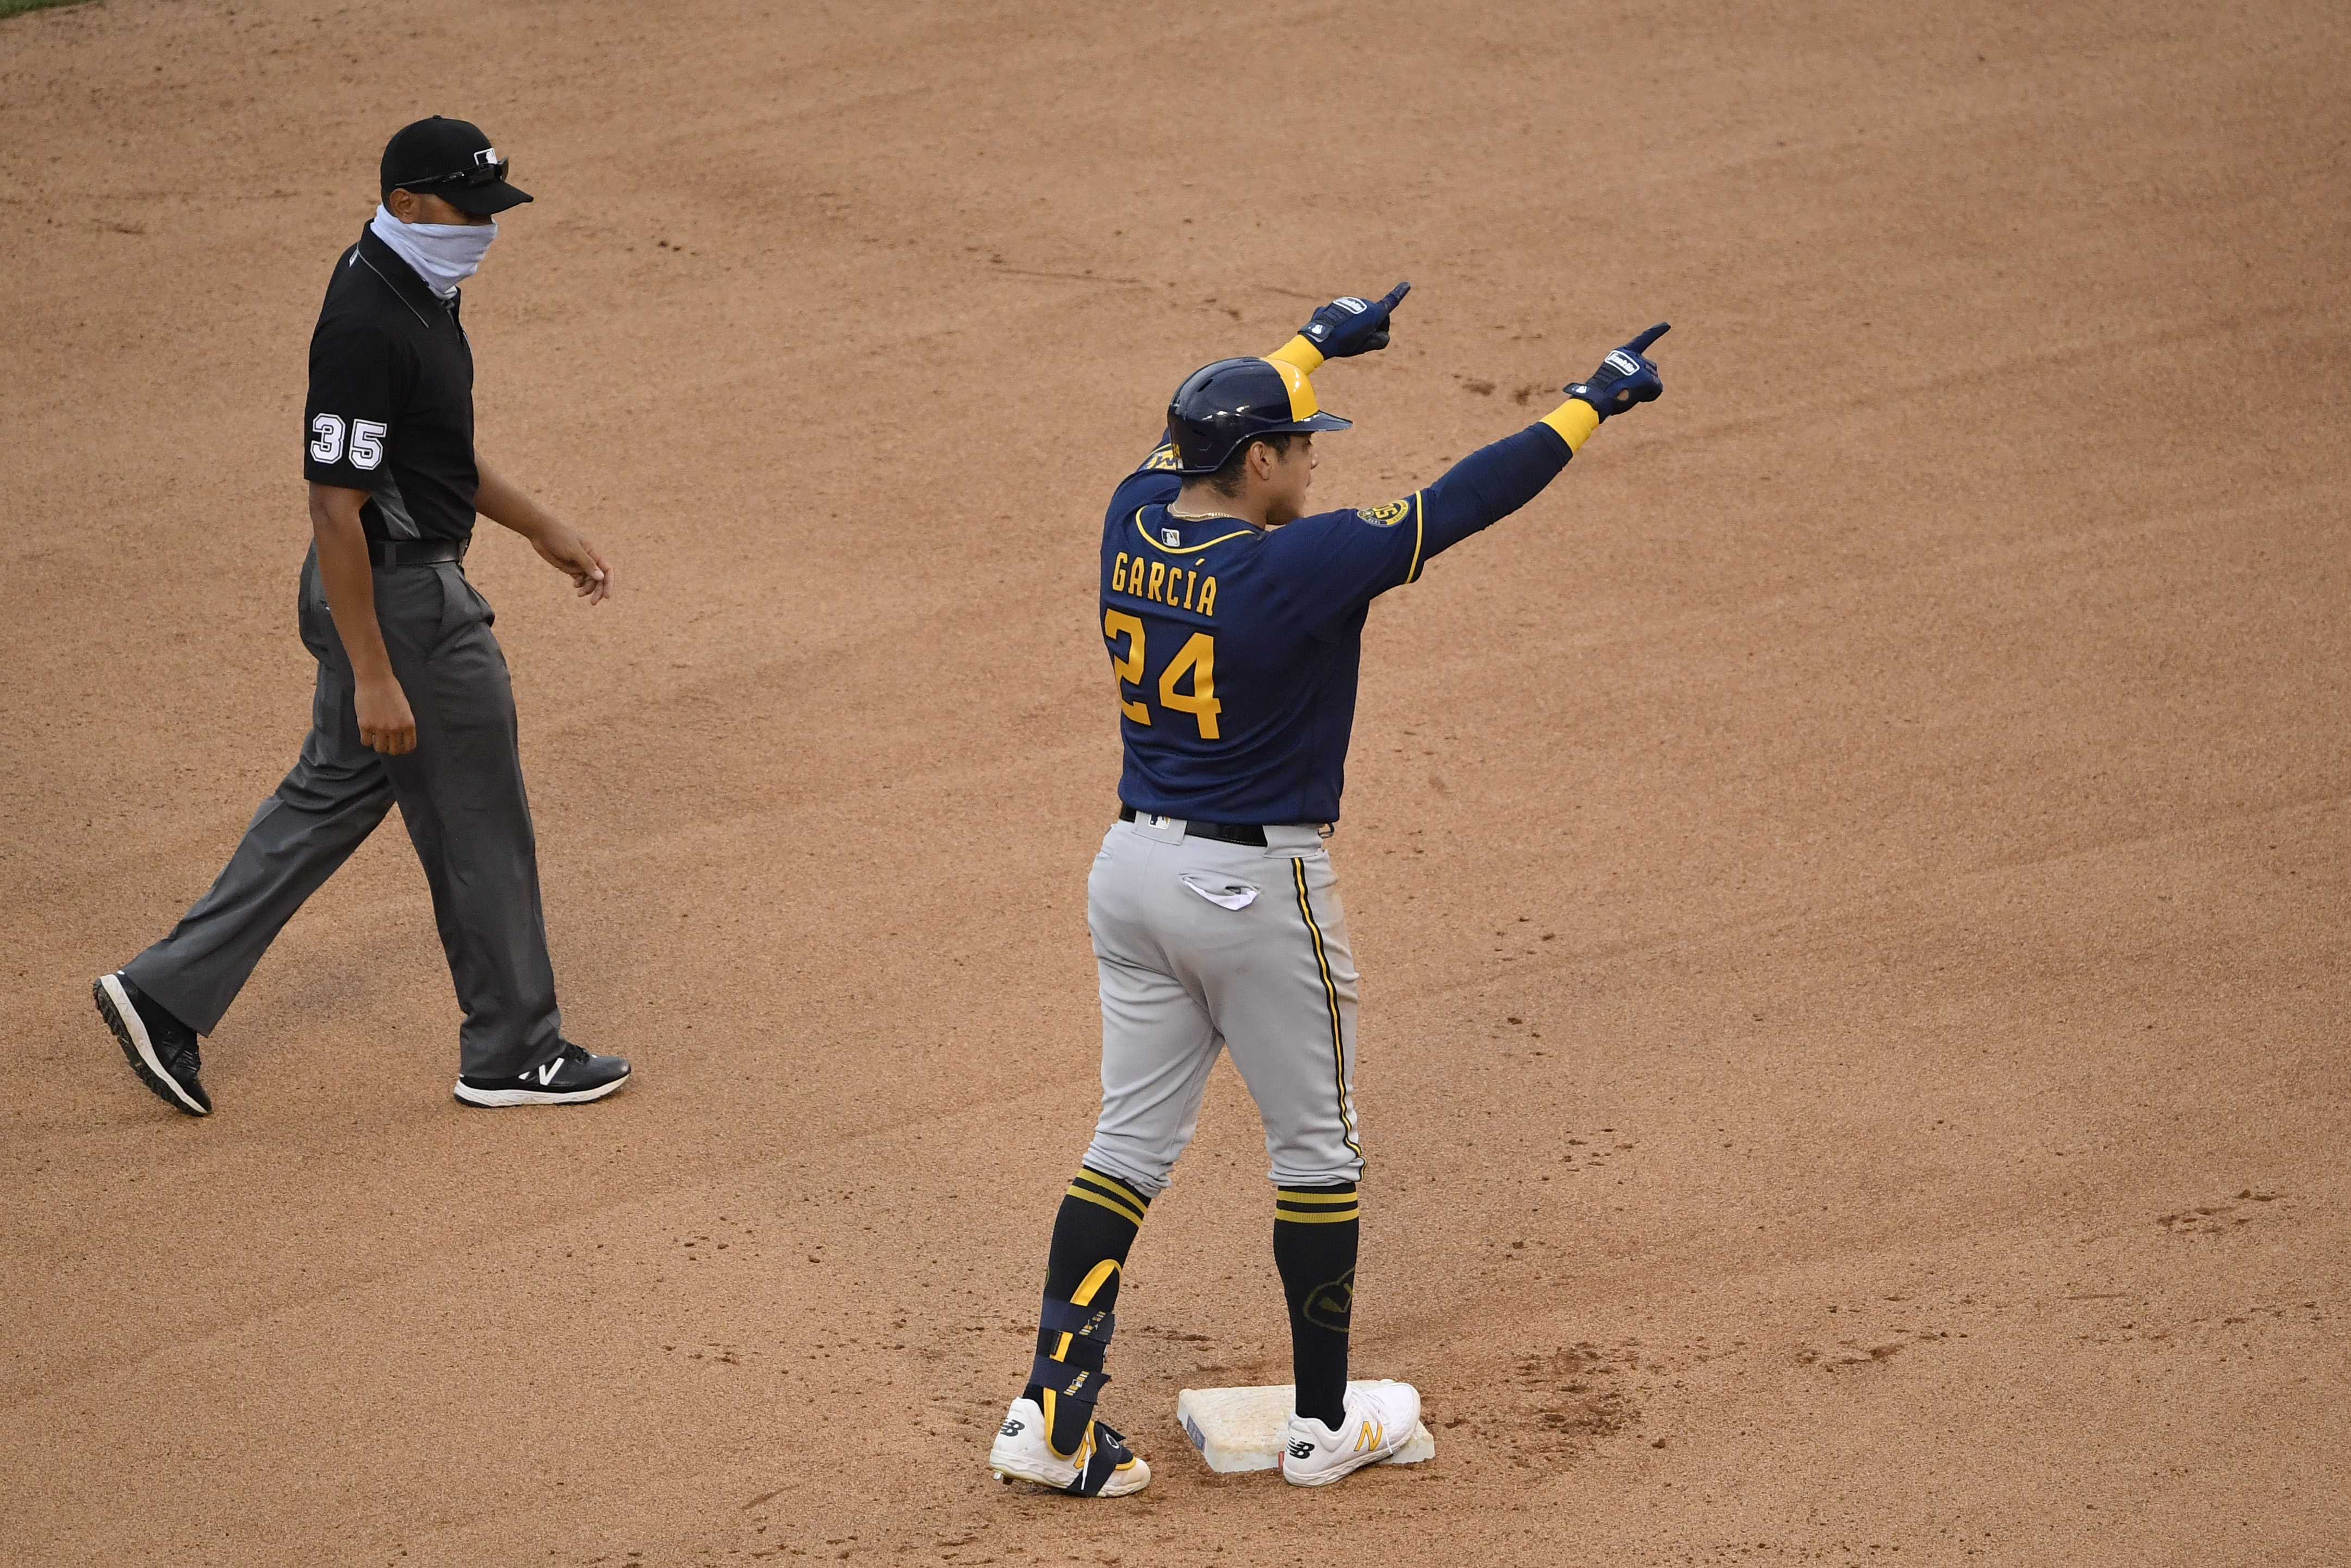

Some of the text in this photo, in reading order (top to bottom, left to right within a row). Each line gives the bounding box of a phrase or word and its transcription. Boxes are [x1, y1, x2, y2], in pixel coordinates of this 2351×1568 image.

[310, 413, 387, 470] 35
[1112, 551, 1217, 617] GARCÍA
[1105, 608, 1221, 739] 24
[1354, 1421, 1383, 1452] N
